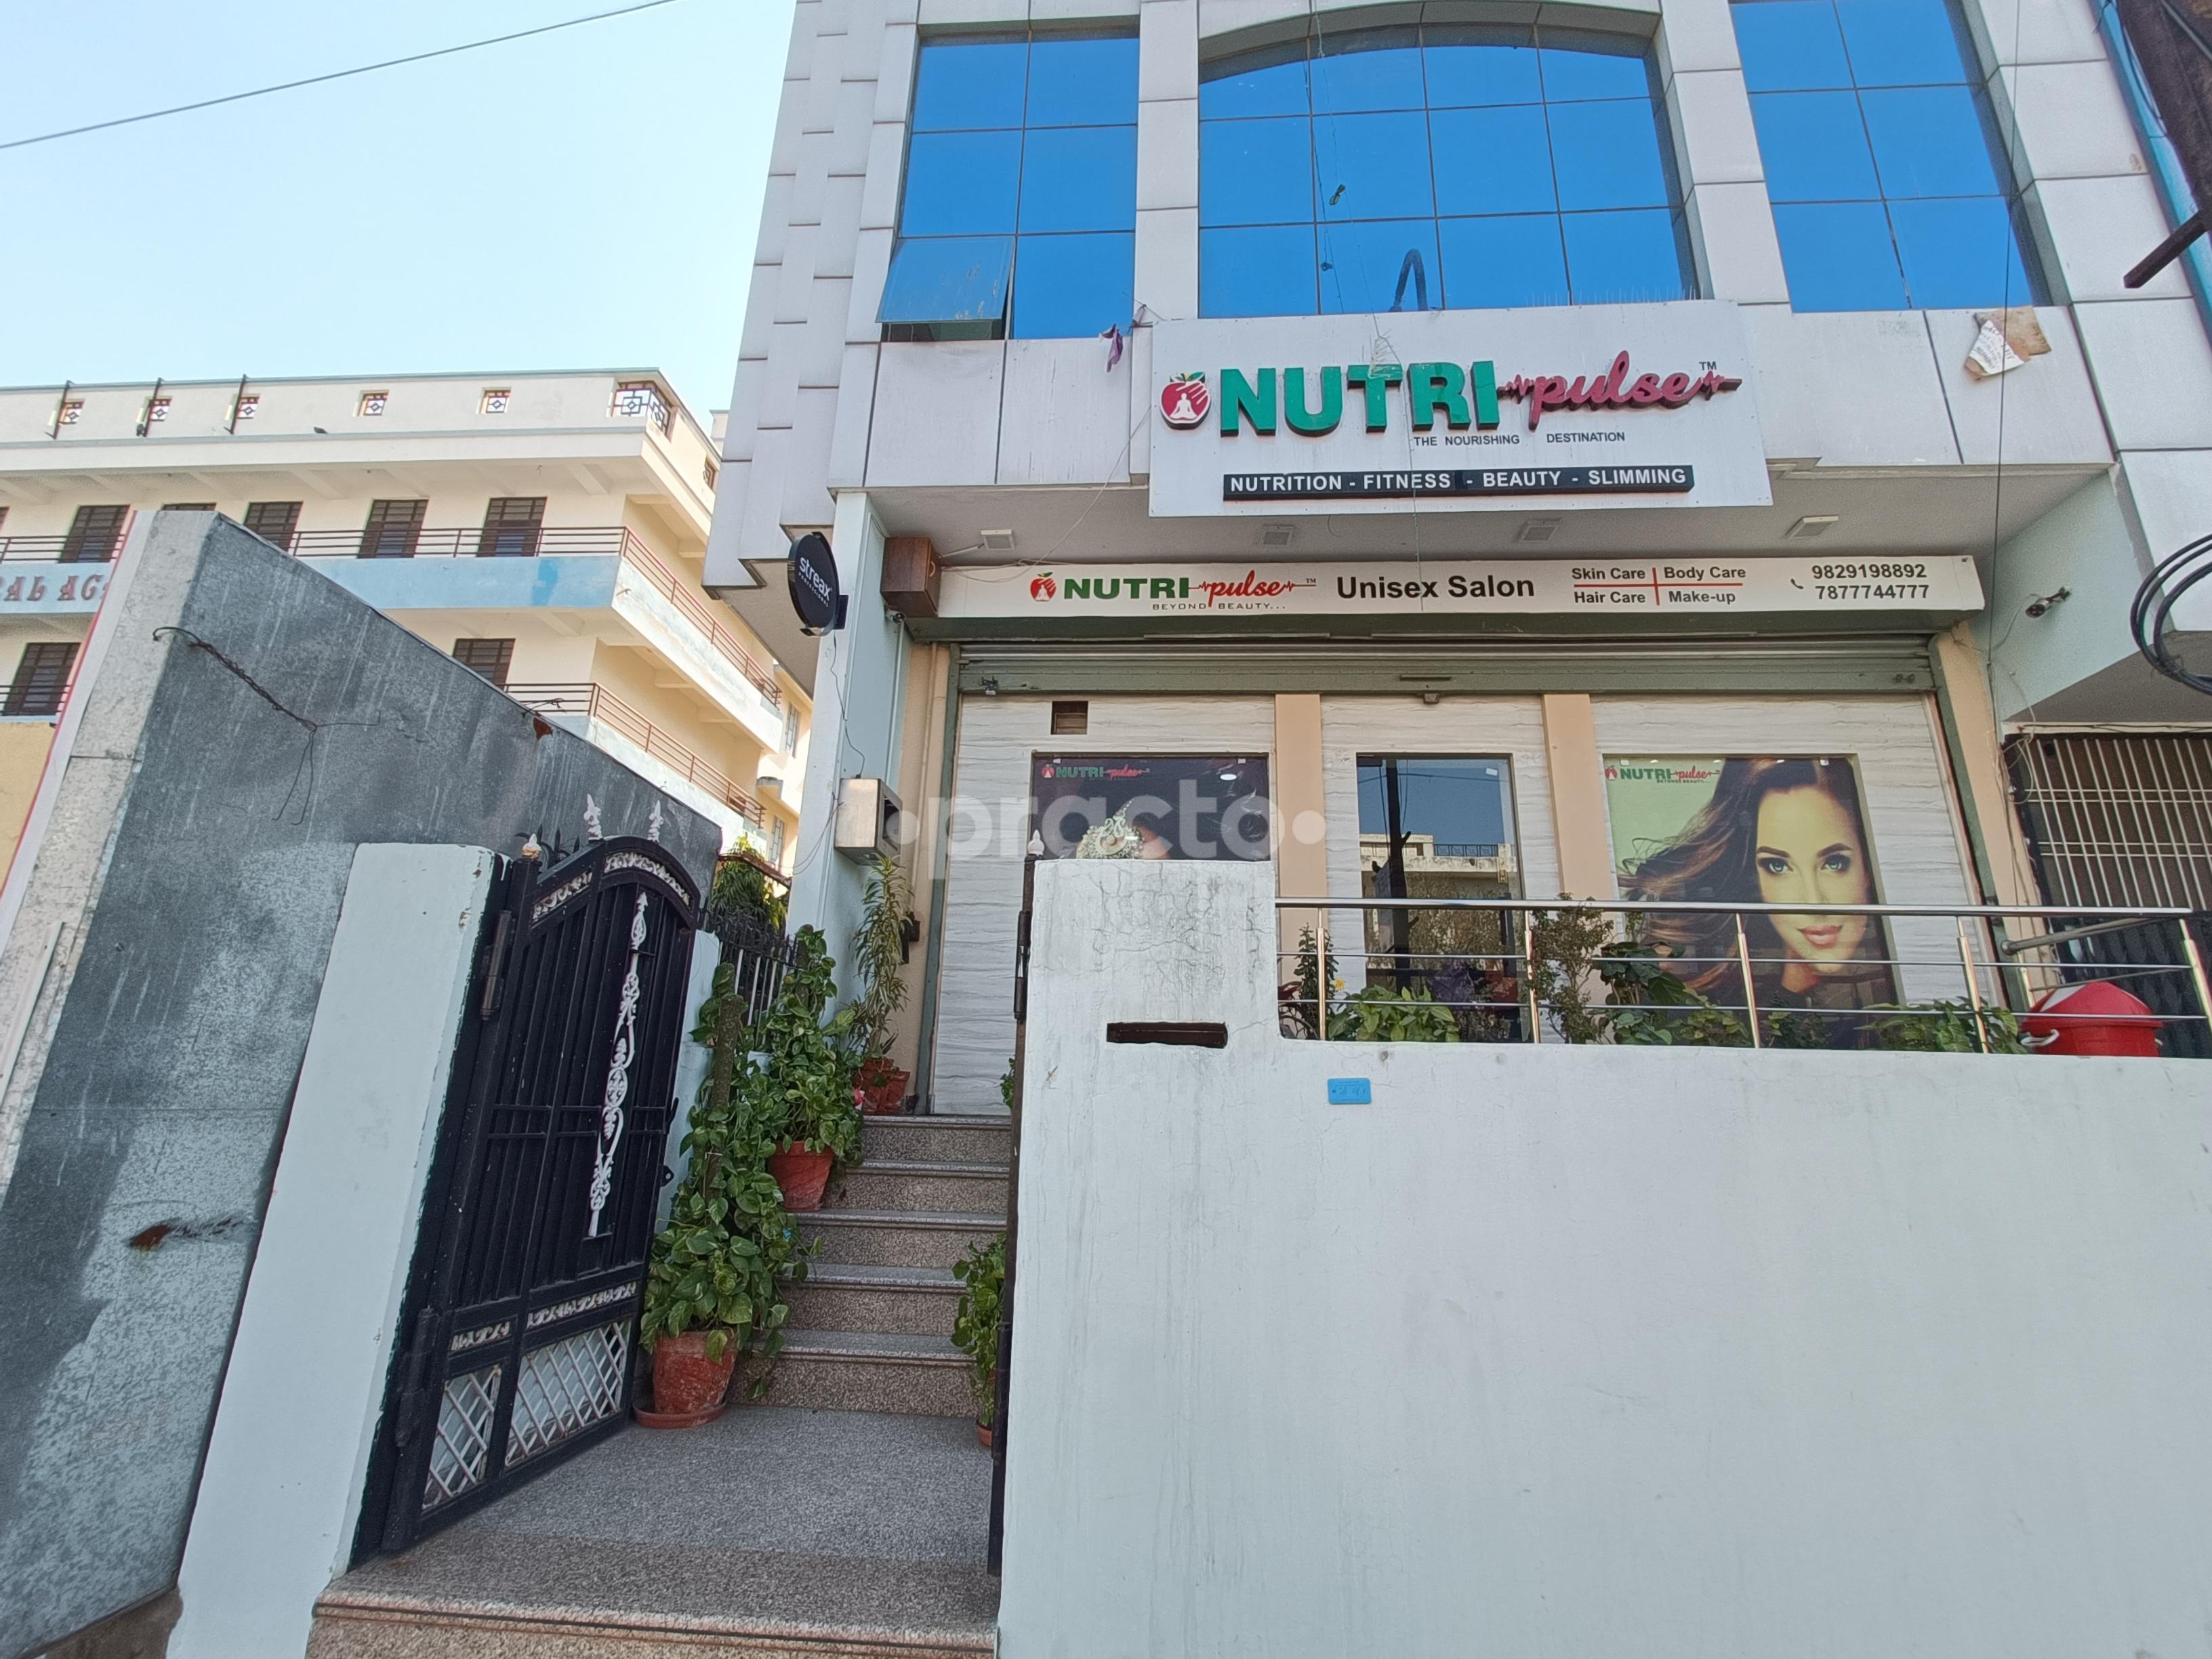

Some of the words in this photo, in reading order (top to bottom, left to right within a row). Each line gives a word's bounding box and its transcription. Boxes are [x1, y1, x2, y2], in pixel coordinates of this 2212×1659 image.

[1220, 361, 1500, 437] NUTRI
[1528, 350, 1702, 433] pulse
[1413, 436, 1437, 447] THE
[1444, 434, 1520, 447] NOURISHING
[1546, 432, 1626, 444] DESTINATION
[1230, 475, 1342, 492] NUTRITION
[1363, 473, 1451, 490] FITNESS
[1482, 470, 1561, 487] BEAUTY
[1588, 468, 1687, 485] SLIMMING
[1572, 567, 1606, 580] Skin
[1610, 567, 1646, 579] Care
[1664, 566, 1705, 581] Body
[1709, 566, 1746, 579] Care
[1811, 564, 1927, 579] 9829198892
[0, 575, 48, 602] AL
[1063, 577, 1189, 600] NUTRI
[1208, 569, 1288, 608] pulse
[1336, 576, 1439, 599] Unisex
[1448, 575, 1535, 598] Salon
[1815, 584, 1929, 600] 7877744777
[1574, 591, 1606, 604] Hair
[1610, 591, 1646, 603] Care
[1668, 590, 1736, 605] Make-up
[1056, 766, 1104, 778] NUTRI
[1620, 769, 1671, 779] NUTRI
[1677, 765, 1708, 781] pulse
